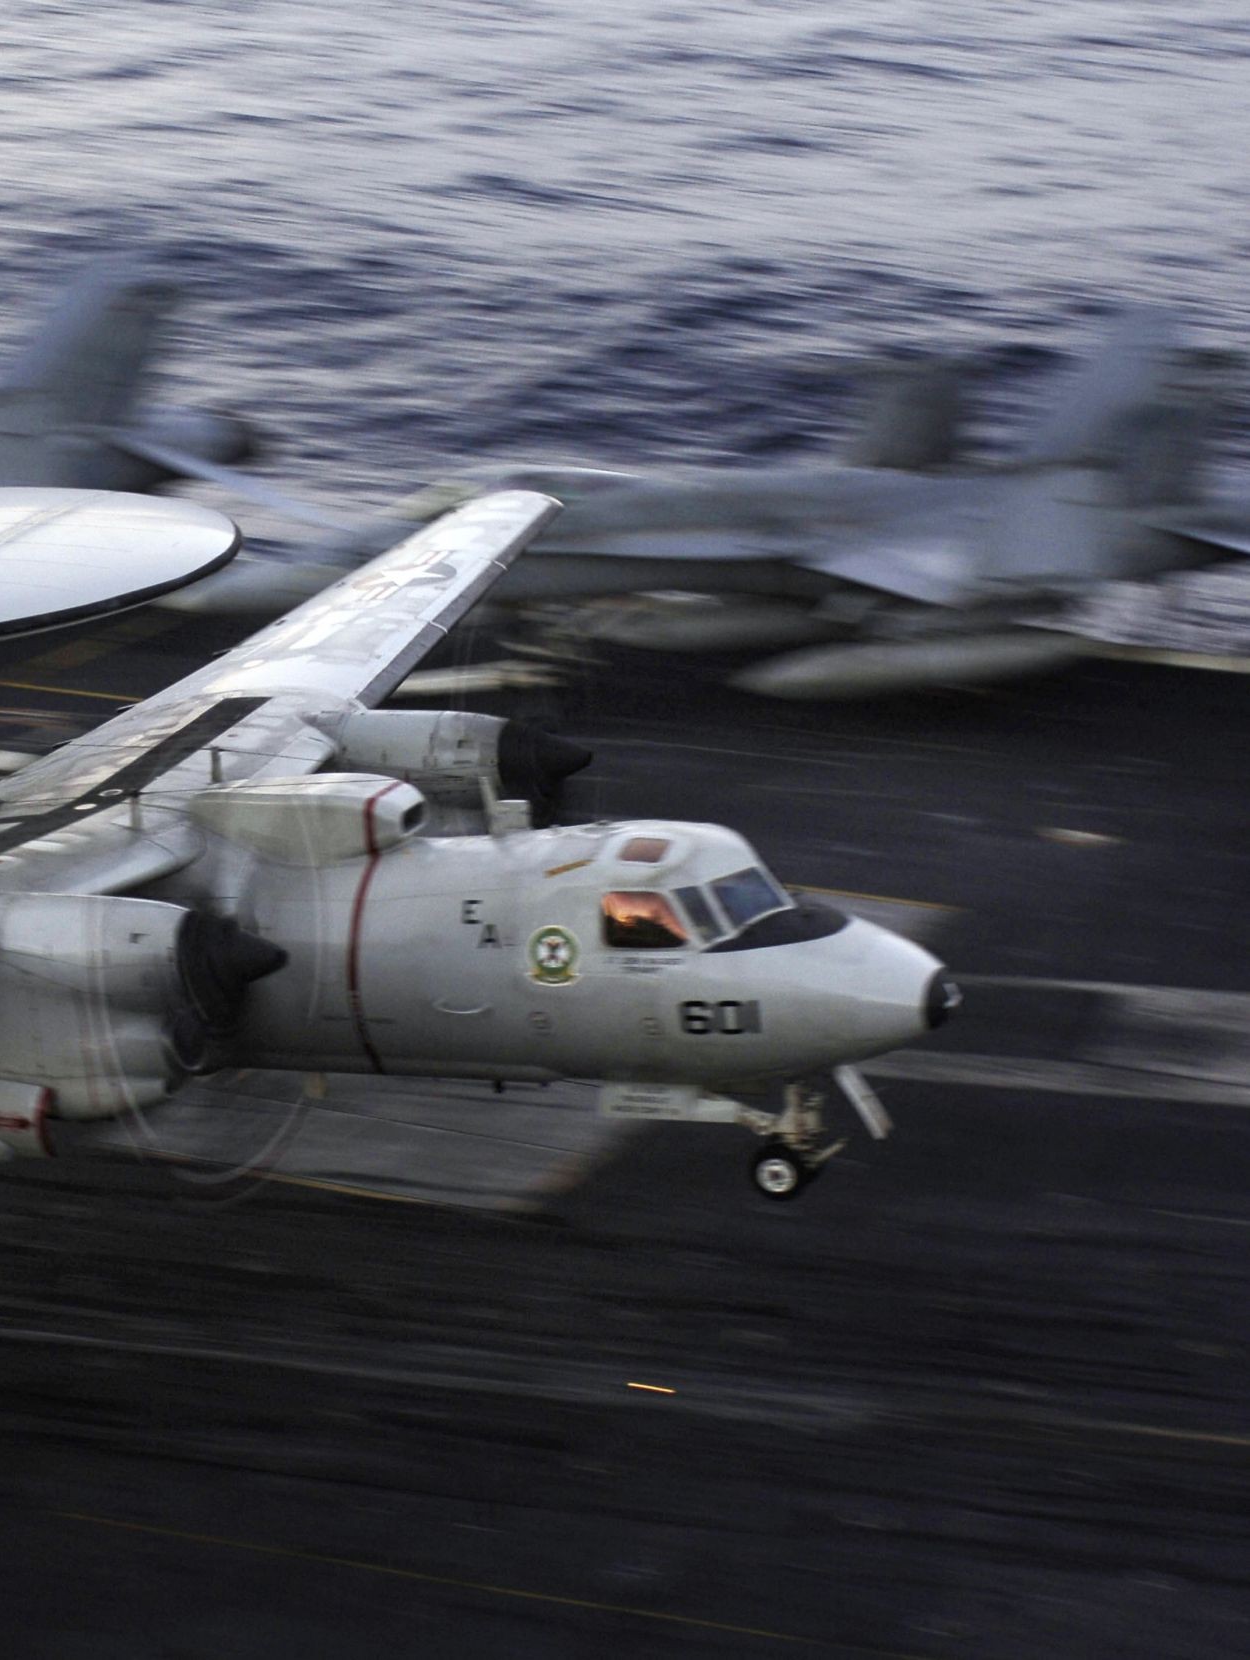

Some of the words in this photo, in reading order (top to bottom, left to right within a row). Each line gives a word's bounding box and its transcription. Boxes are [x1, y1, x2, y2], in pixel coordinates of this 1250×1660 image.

[461, 899, 484, 925] E
[477, 924, 503, 949] A
[678, 1000, 762, 1035] 601
